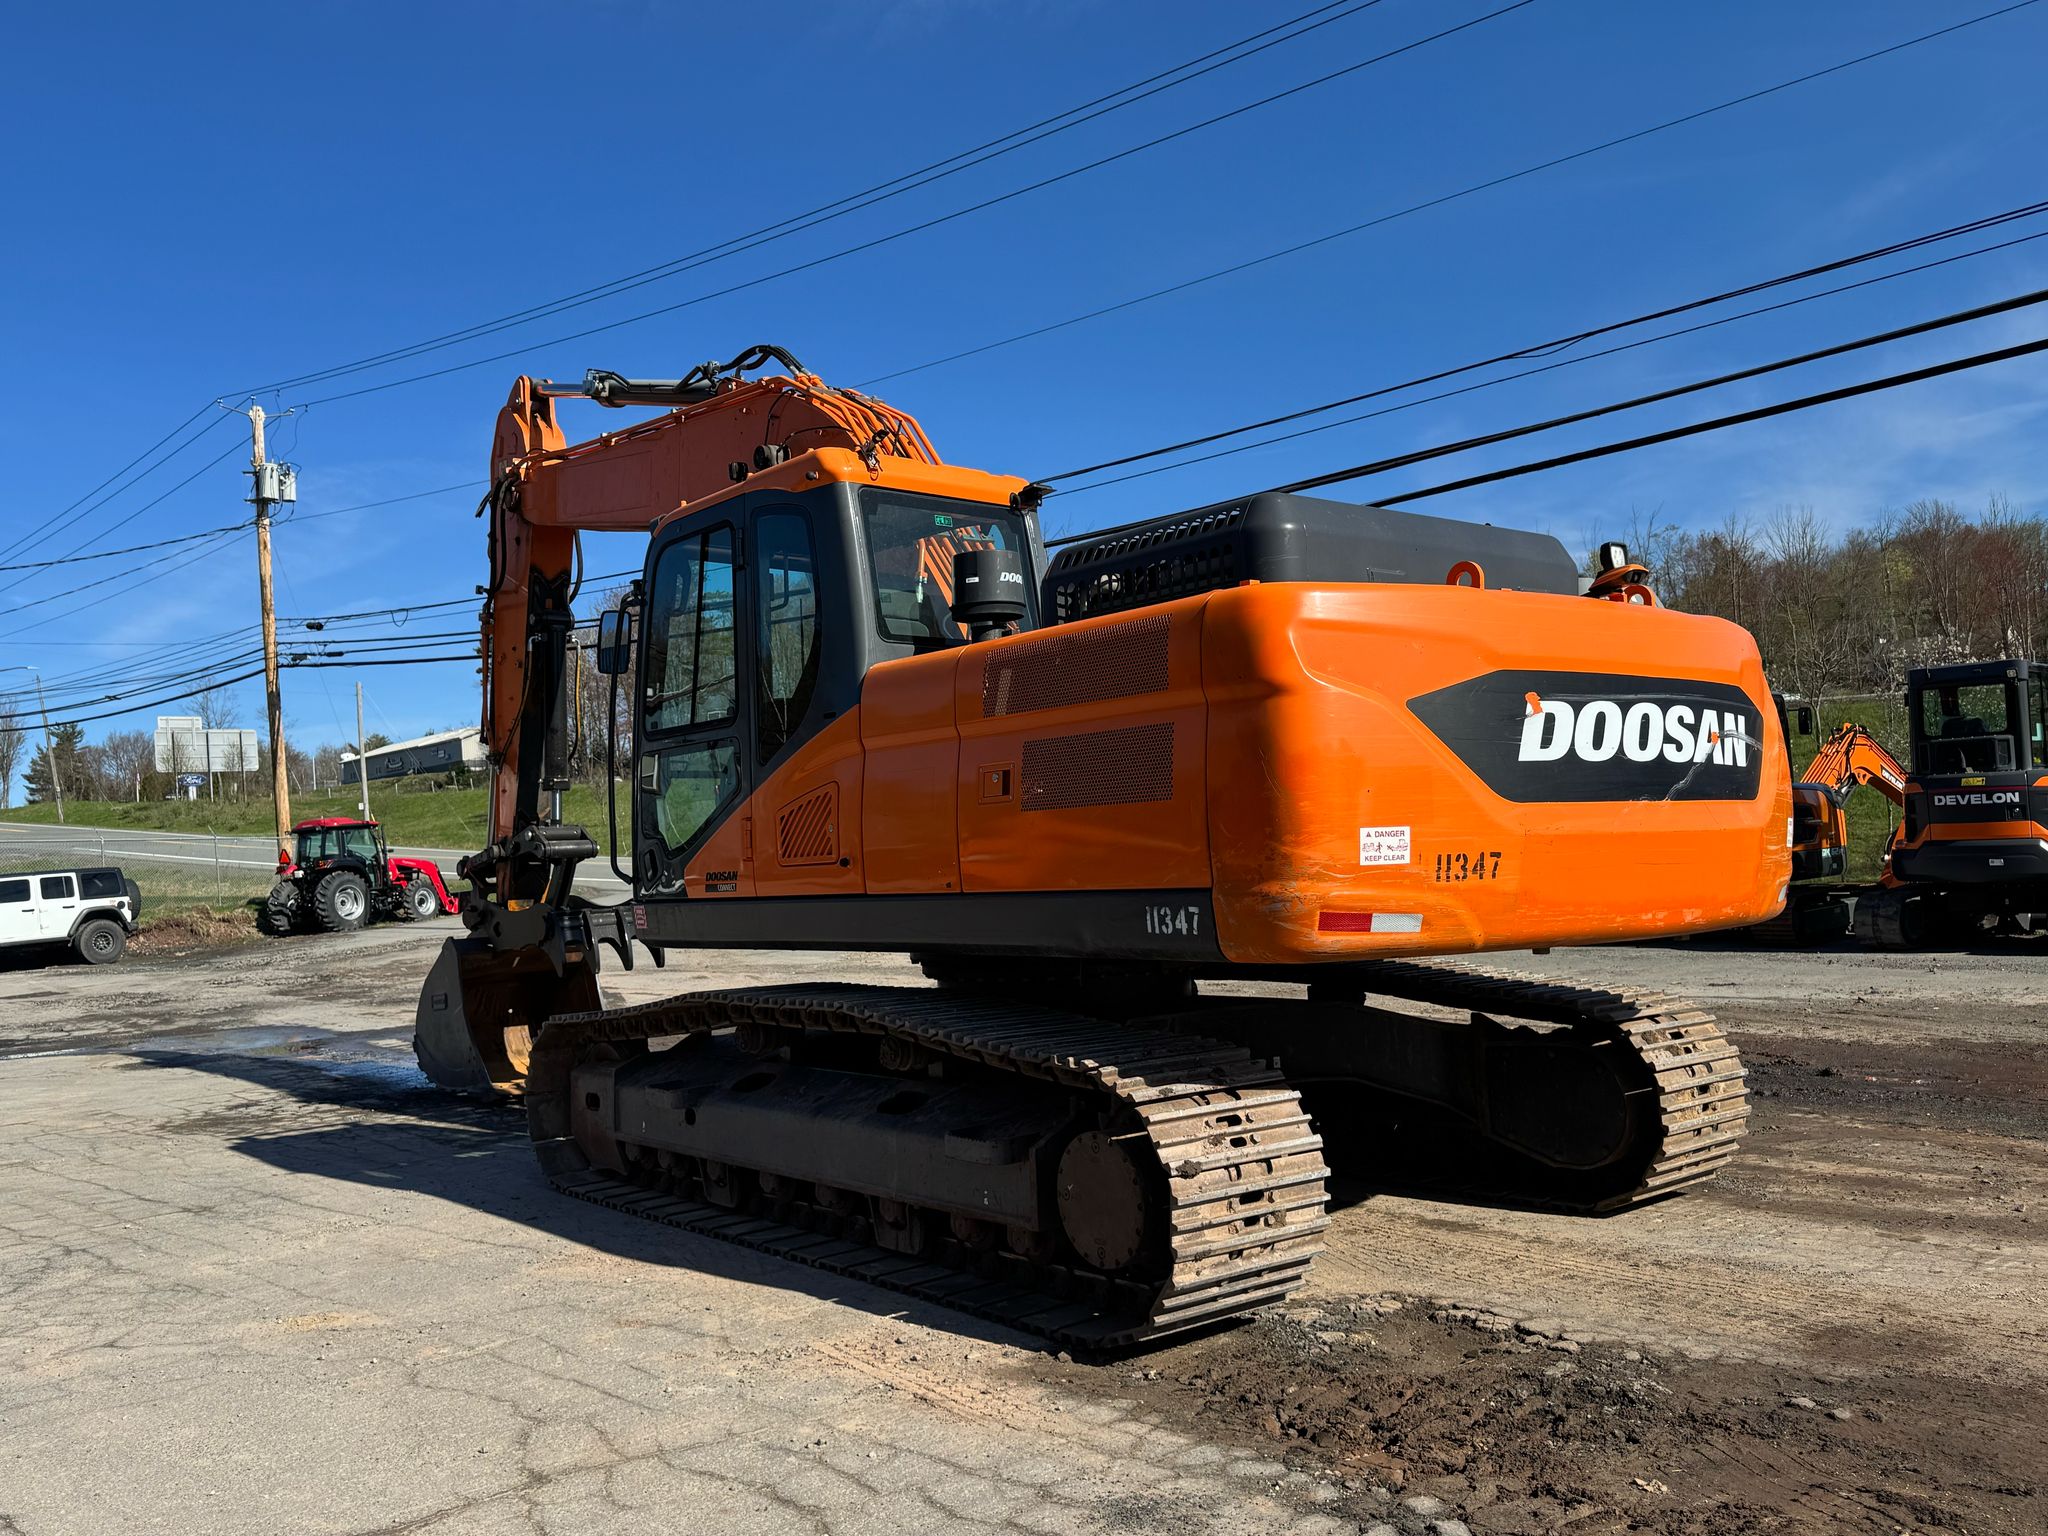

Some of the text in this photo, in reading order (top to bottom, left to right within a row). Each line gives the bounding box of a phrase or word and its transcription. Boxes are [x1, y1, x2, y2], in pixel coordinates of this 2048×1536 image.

[1518, 700, 1747, 767] DOOSAN
[1934, 792, 2020, 806] DEVELON
[1374, 830, 1405, 838] DANGER
[1435, 852, 1502, 882] 11347
[705, 871, 738, 881] DOOSAN
[717, 883, 736, 891] CONNECT
[1145, 906, 1199, 935] 11347
